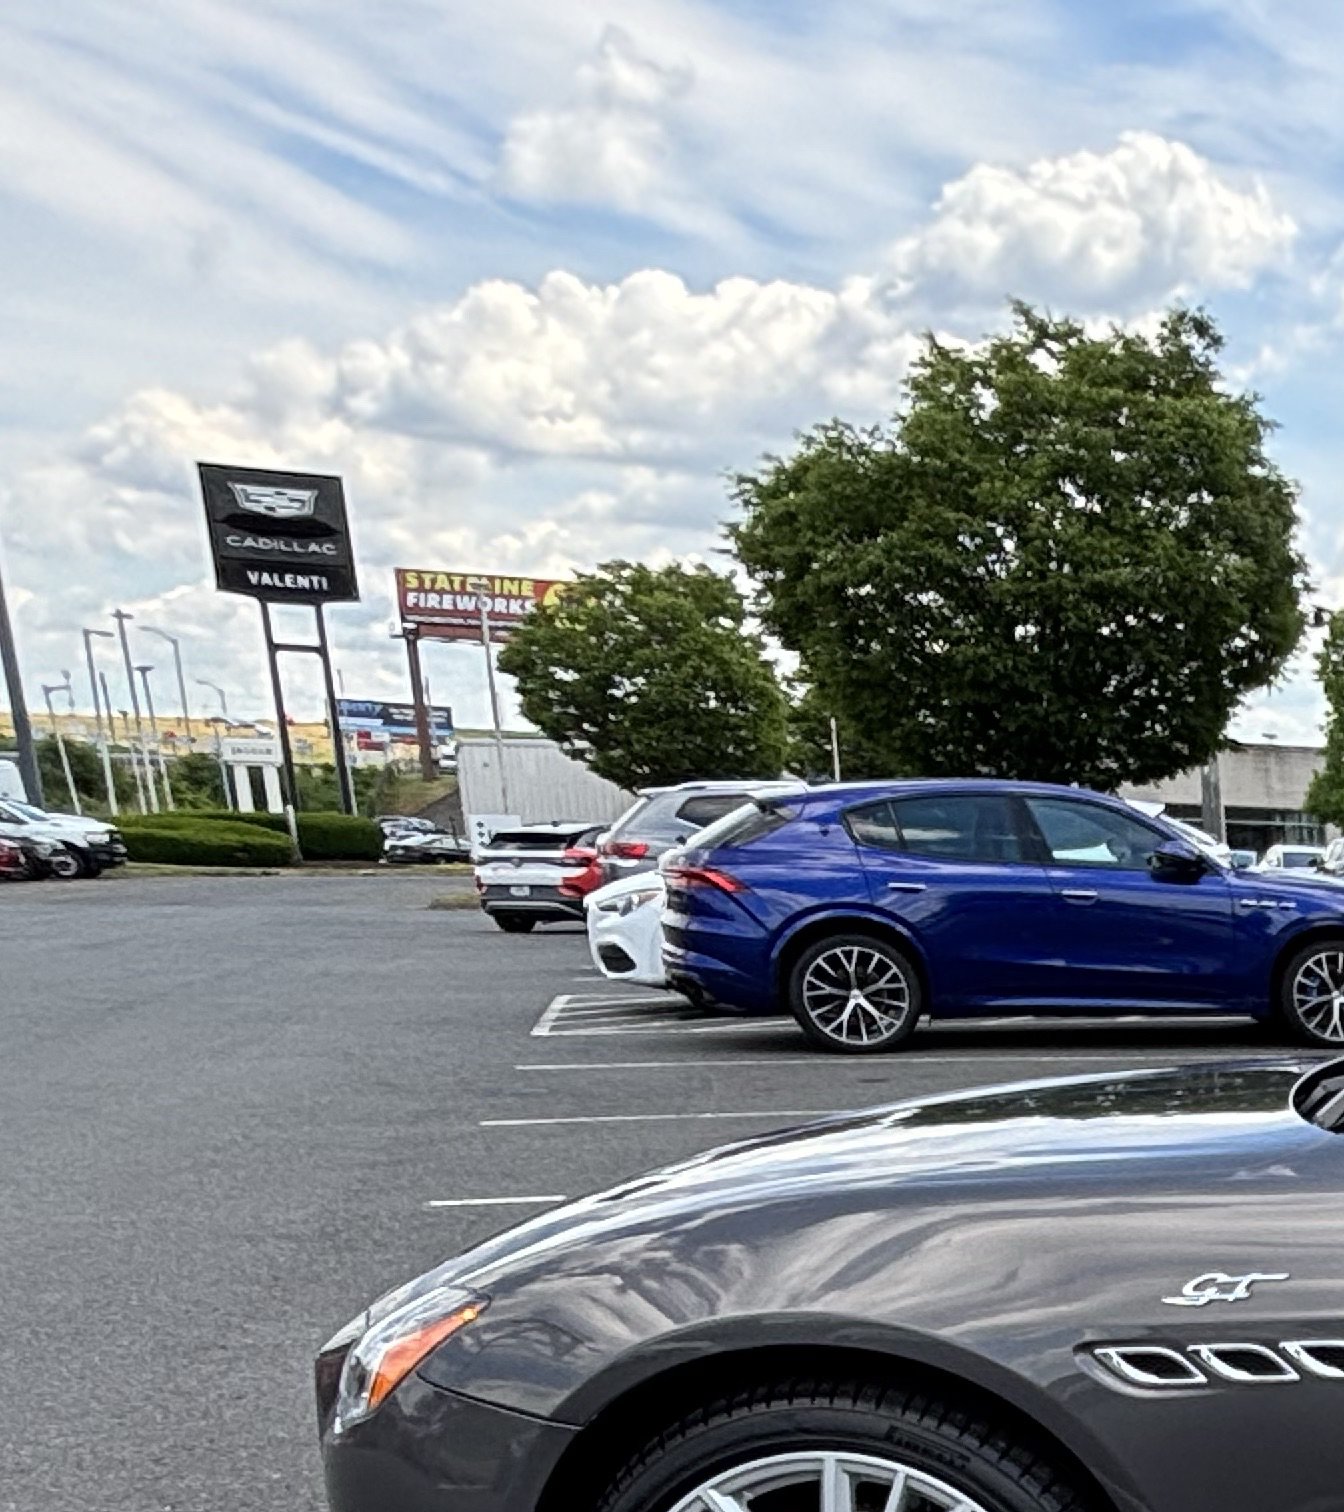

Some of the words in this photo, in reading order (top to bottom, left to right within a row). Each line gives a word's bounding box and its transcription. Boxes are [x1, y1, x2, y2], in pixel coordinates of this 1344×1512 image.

[225, 535, 337, 555] CADILLAC
[246, 570, 329, 591] VALENTI
[406, 592, 537, 614] FIREWORKS
